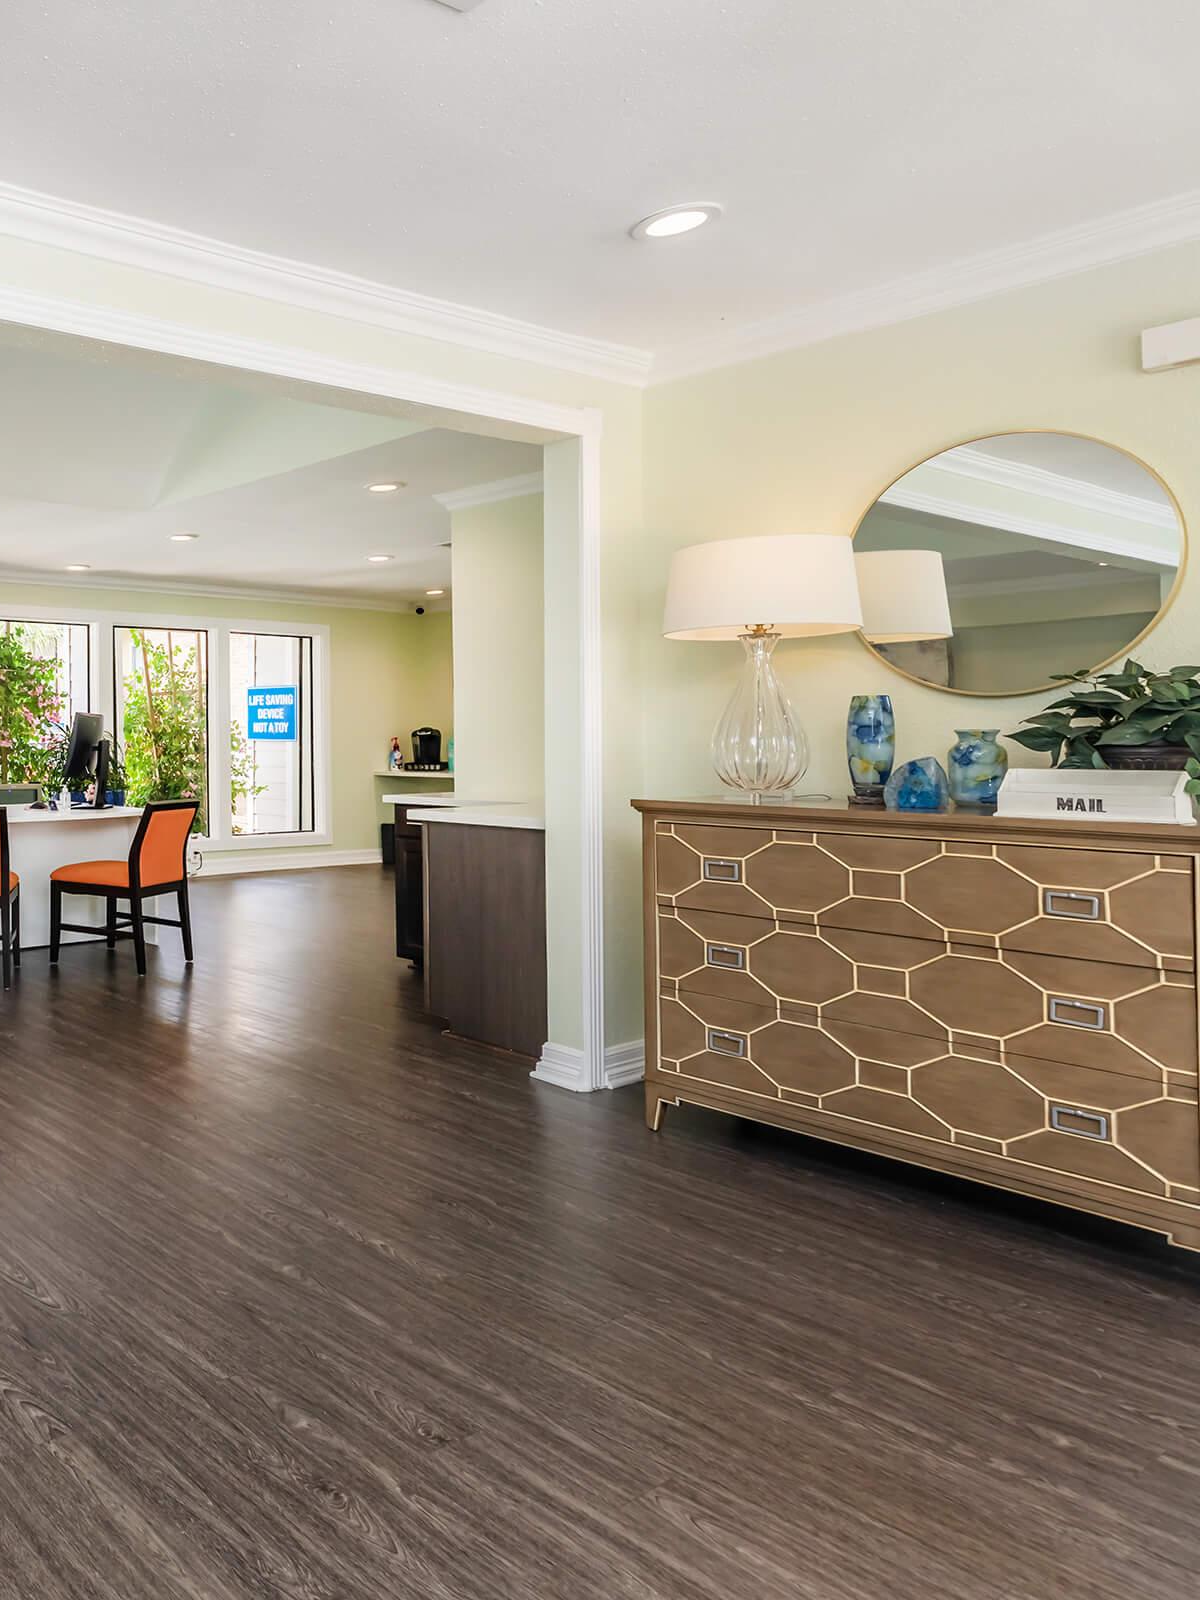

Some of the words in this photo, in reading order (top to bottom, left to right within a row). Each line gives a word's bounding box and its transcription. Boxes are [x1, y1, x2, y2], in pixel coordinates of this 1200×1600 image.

[249, 695, 264, 706] LIFE
[265, 694, 293, 705] SAVING
[257, 708, 285, 719] DEVICE
[253, 722, 268, 733] NOT
[274, 722, 289, 733] TOY
[1057, 797, 1107, 813] MAIL
